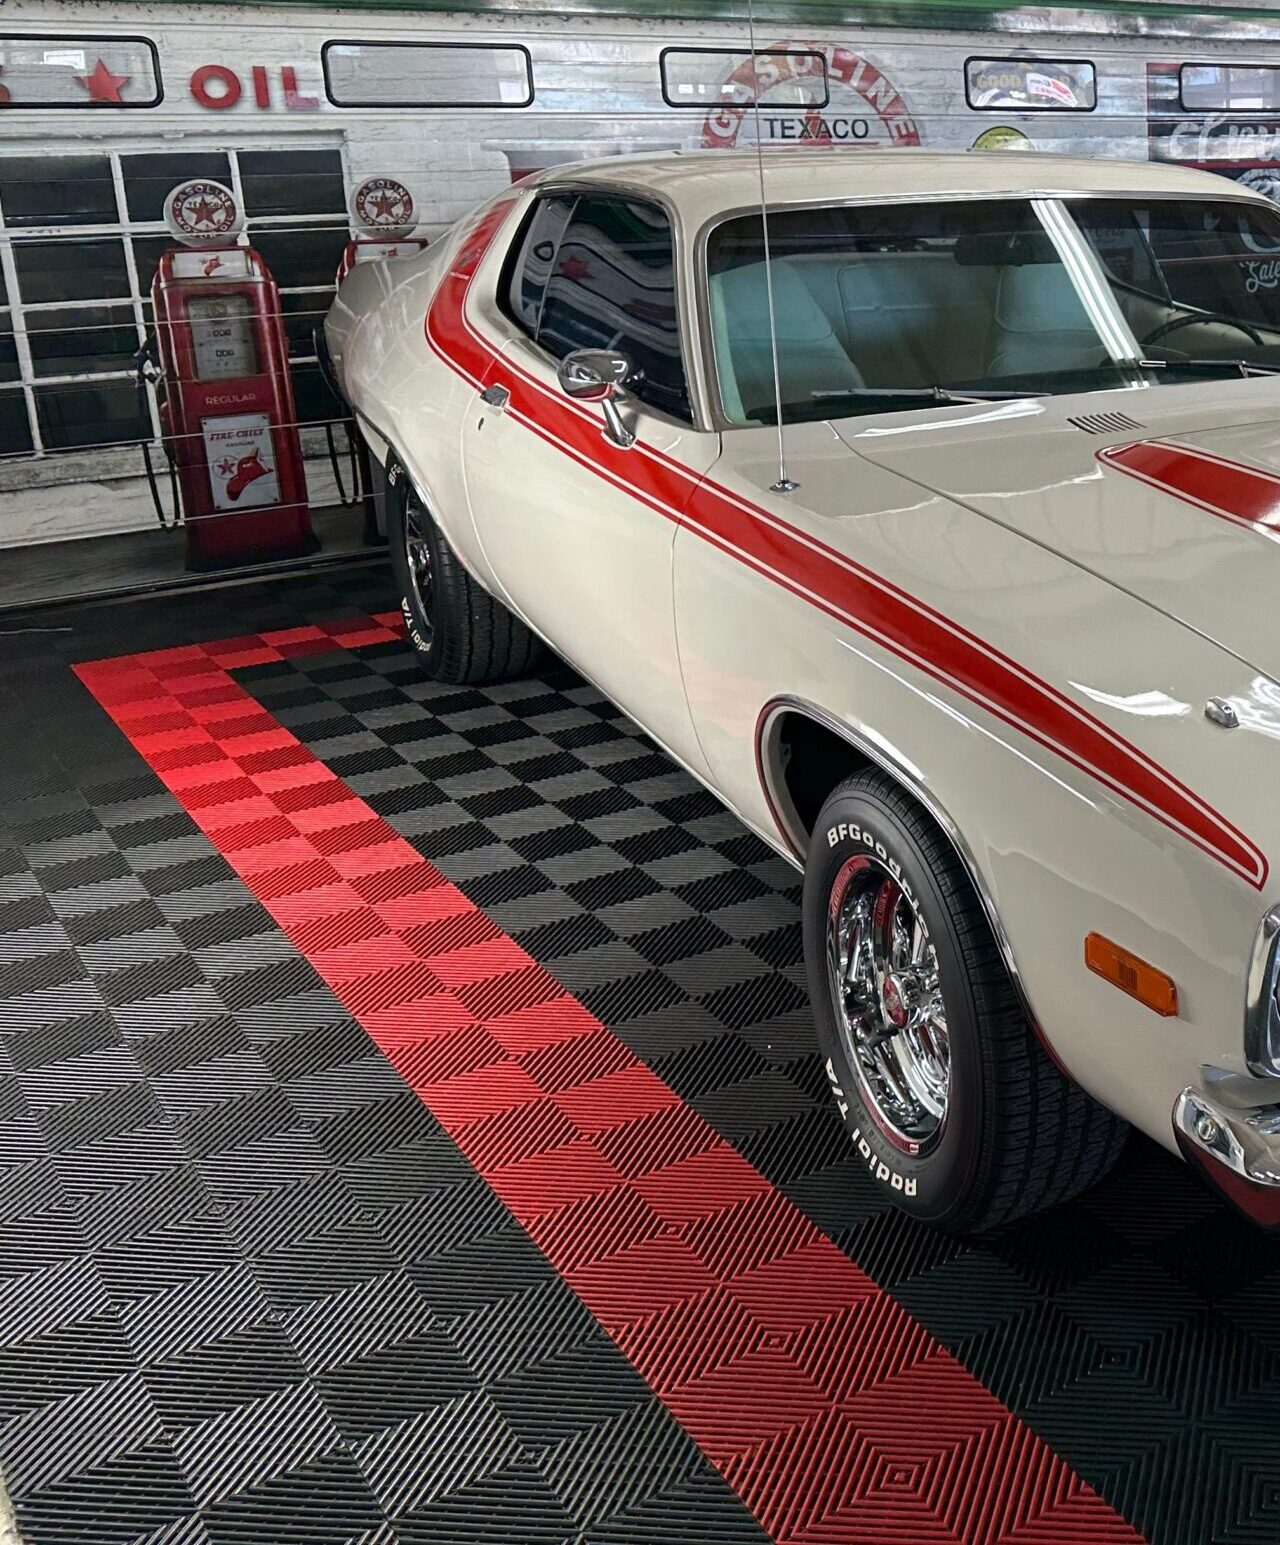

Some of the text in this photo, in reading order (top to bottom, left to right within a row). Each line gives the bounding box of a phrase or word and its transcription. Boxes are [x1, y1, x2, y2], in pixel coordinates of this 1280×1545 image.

[189, 63, 321, 110] OIL
[708, 44, 917, 142] GASOLINE
[763, 118, 870, 140] TEXACO
[173, 184, 233, 209] GASOLINE
[205, 392, 257, 406] REGULAR
[825, 1057, 849, 1121] T/A
[851, 1127, 917, 1197] Radial
